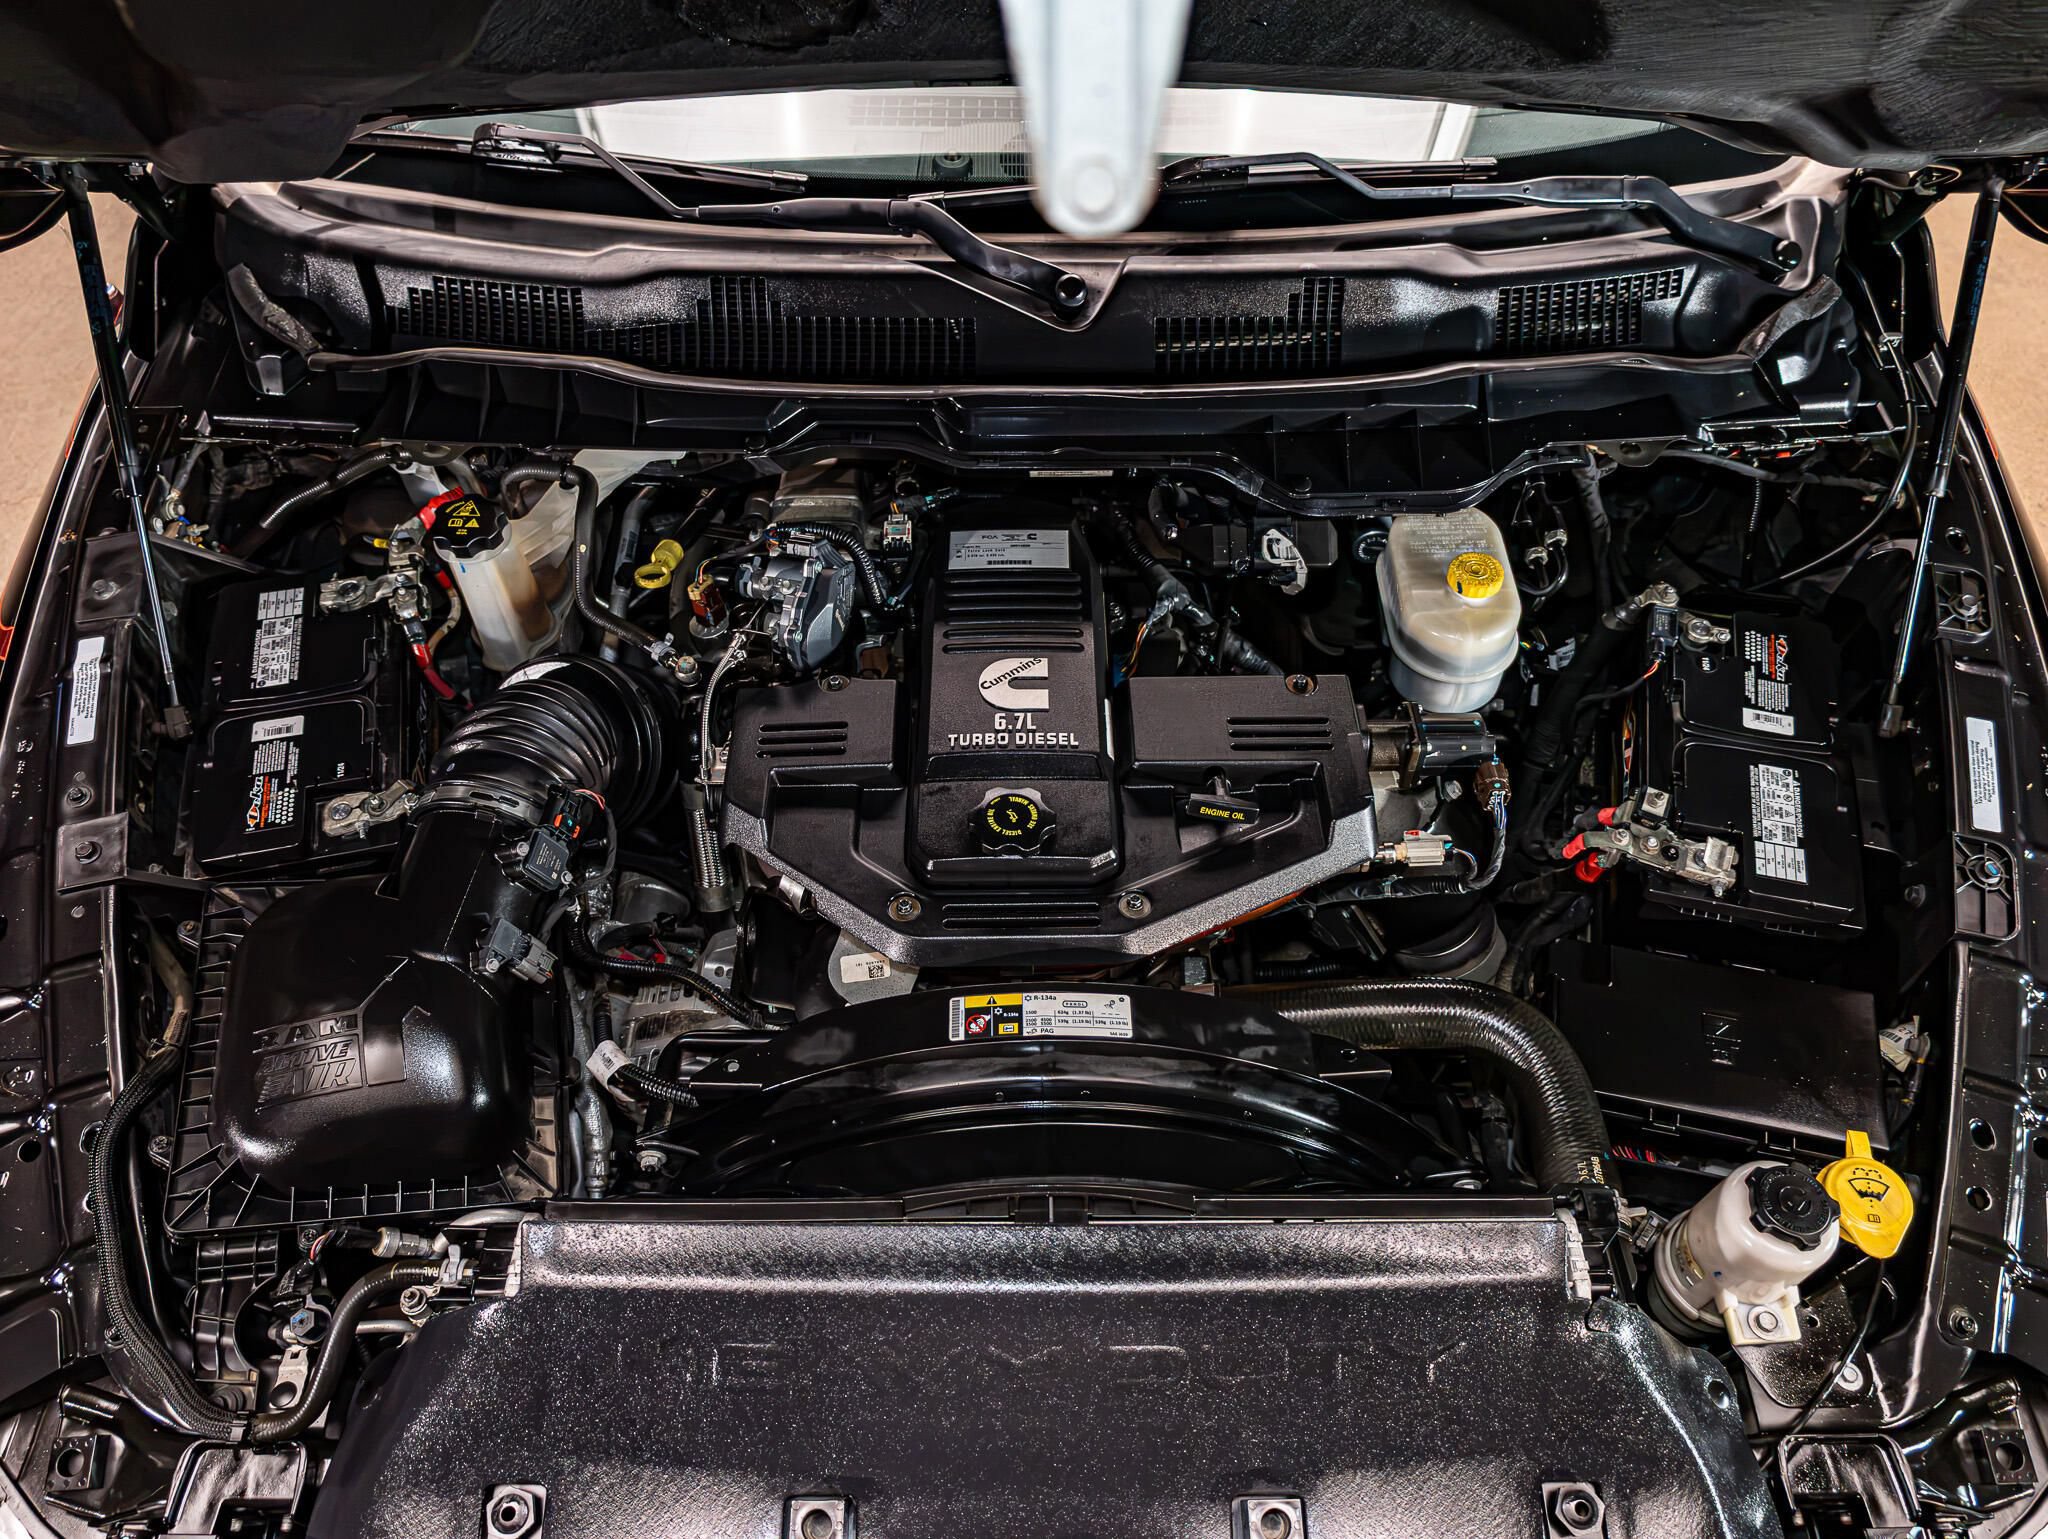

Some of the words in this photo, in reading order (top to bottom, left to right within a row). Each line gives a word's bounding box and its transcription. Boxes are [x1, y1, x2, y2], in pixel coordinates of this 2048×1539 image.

[980, 657, 1042, 690] Cummins
[994, 712, 1037, 730] 6.7L
[948, 732, 1009, 747] TURBO
[1016, 732, 1079, 746] DIESEL
[1200, 806, 1230, 818] ENGINE
[1232, 812, 1245, 820] OIL
[260, 1014, 358, 1047] RAM
